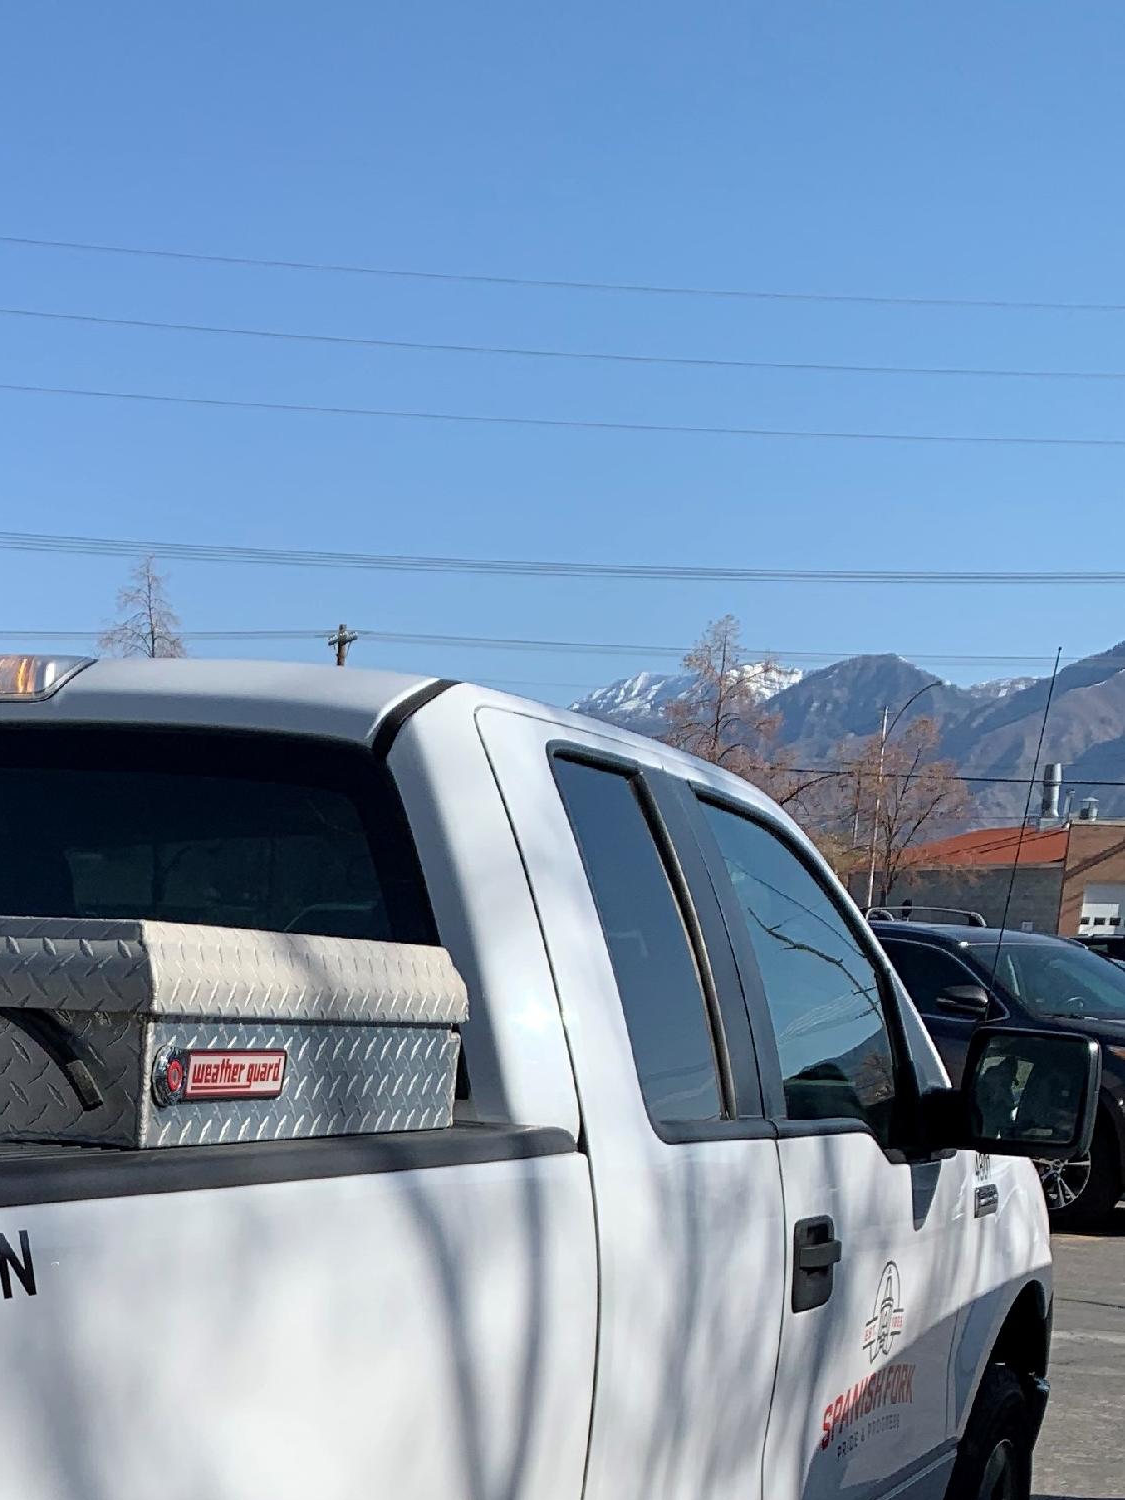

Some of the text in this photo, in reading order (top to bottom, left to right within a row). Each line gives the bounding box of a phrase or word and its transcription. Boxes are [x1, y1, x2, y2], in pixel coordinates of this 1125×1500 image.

[192, 1058, 282, 1088] weather guard
[820, 1363, 916, 1451] SPANISH FORK
